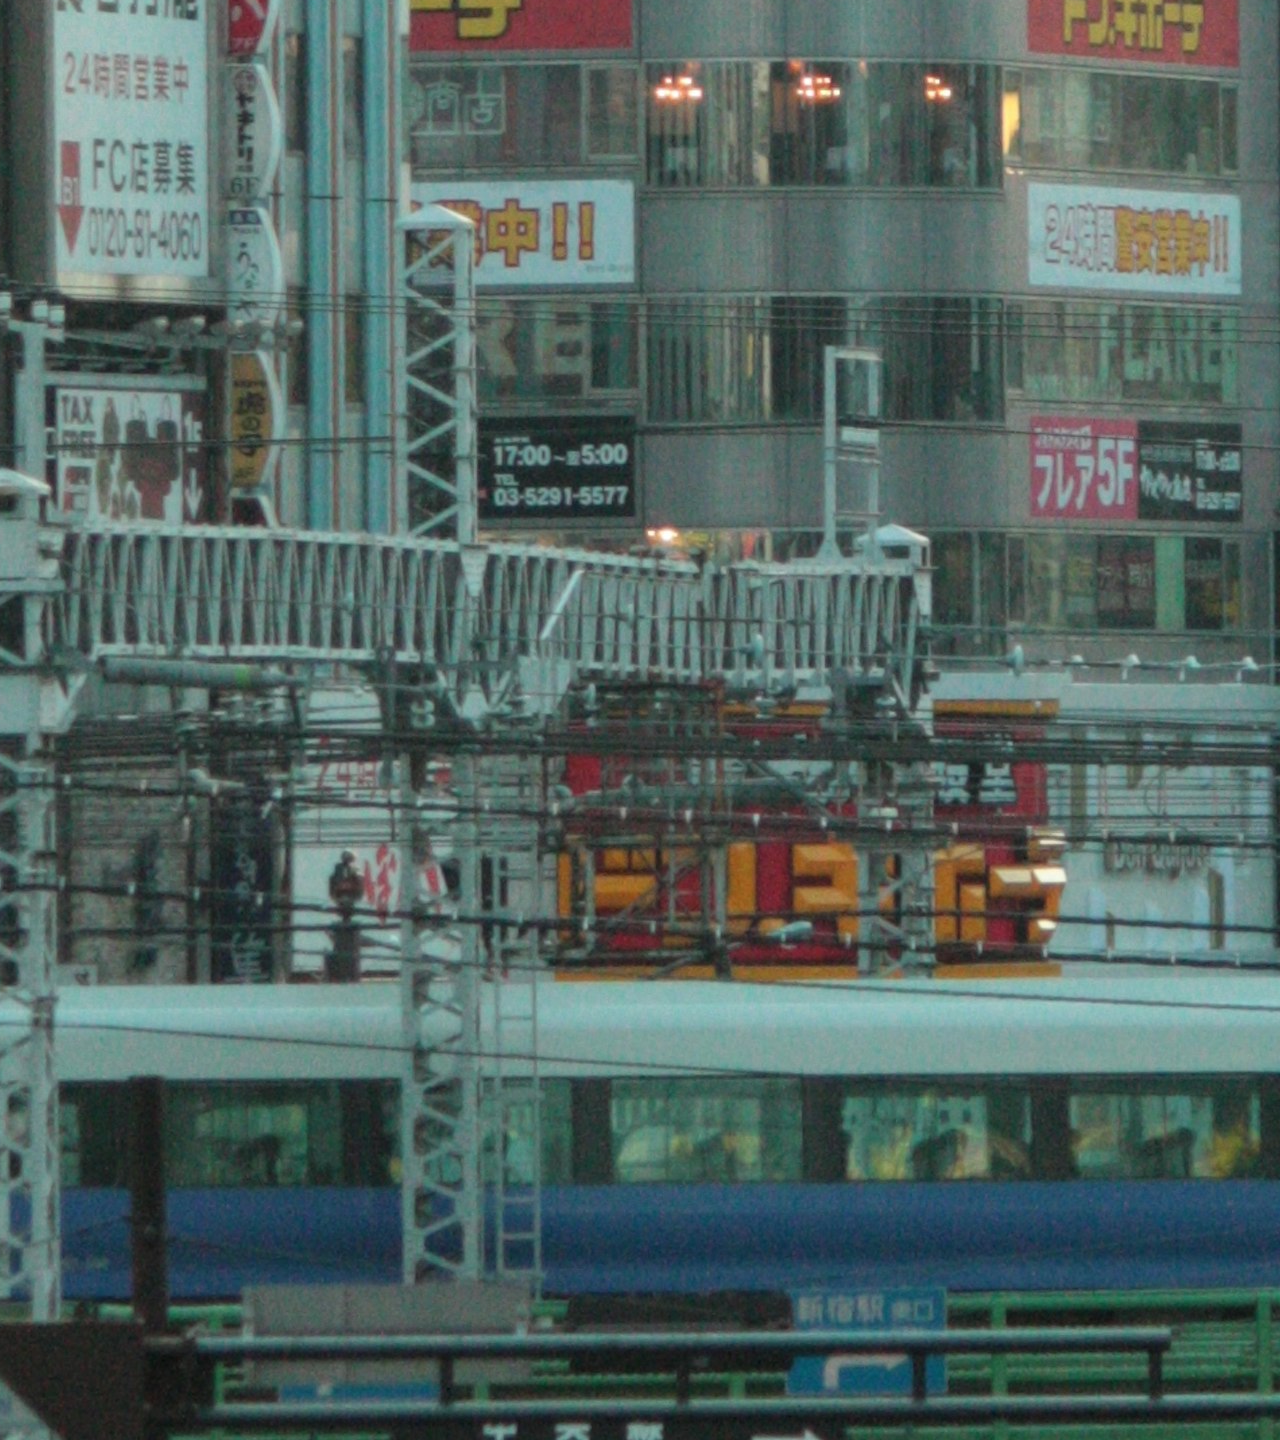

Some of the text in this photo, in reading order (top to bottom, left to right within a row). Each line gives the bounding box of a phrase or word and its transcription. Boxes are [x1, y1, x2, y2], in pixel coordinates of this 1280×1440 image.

[63, 51, 190, 105] 24時間営業中
[91, 139, 196, 197] FC店募集
[229, 176, 260, 196] 6F
[88, 207, 202, 262] 0120-81-4060
[62, 394, 96, 425] TAX
[493, 487, 628, 507] 03-5291-5577
[1035, 450, 1094, 512] フレア
[1096, 434, 1135, 508] 5F
